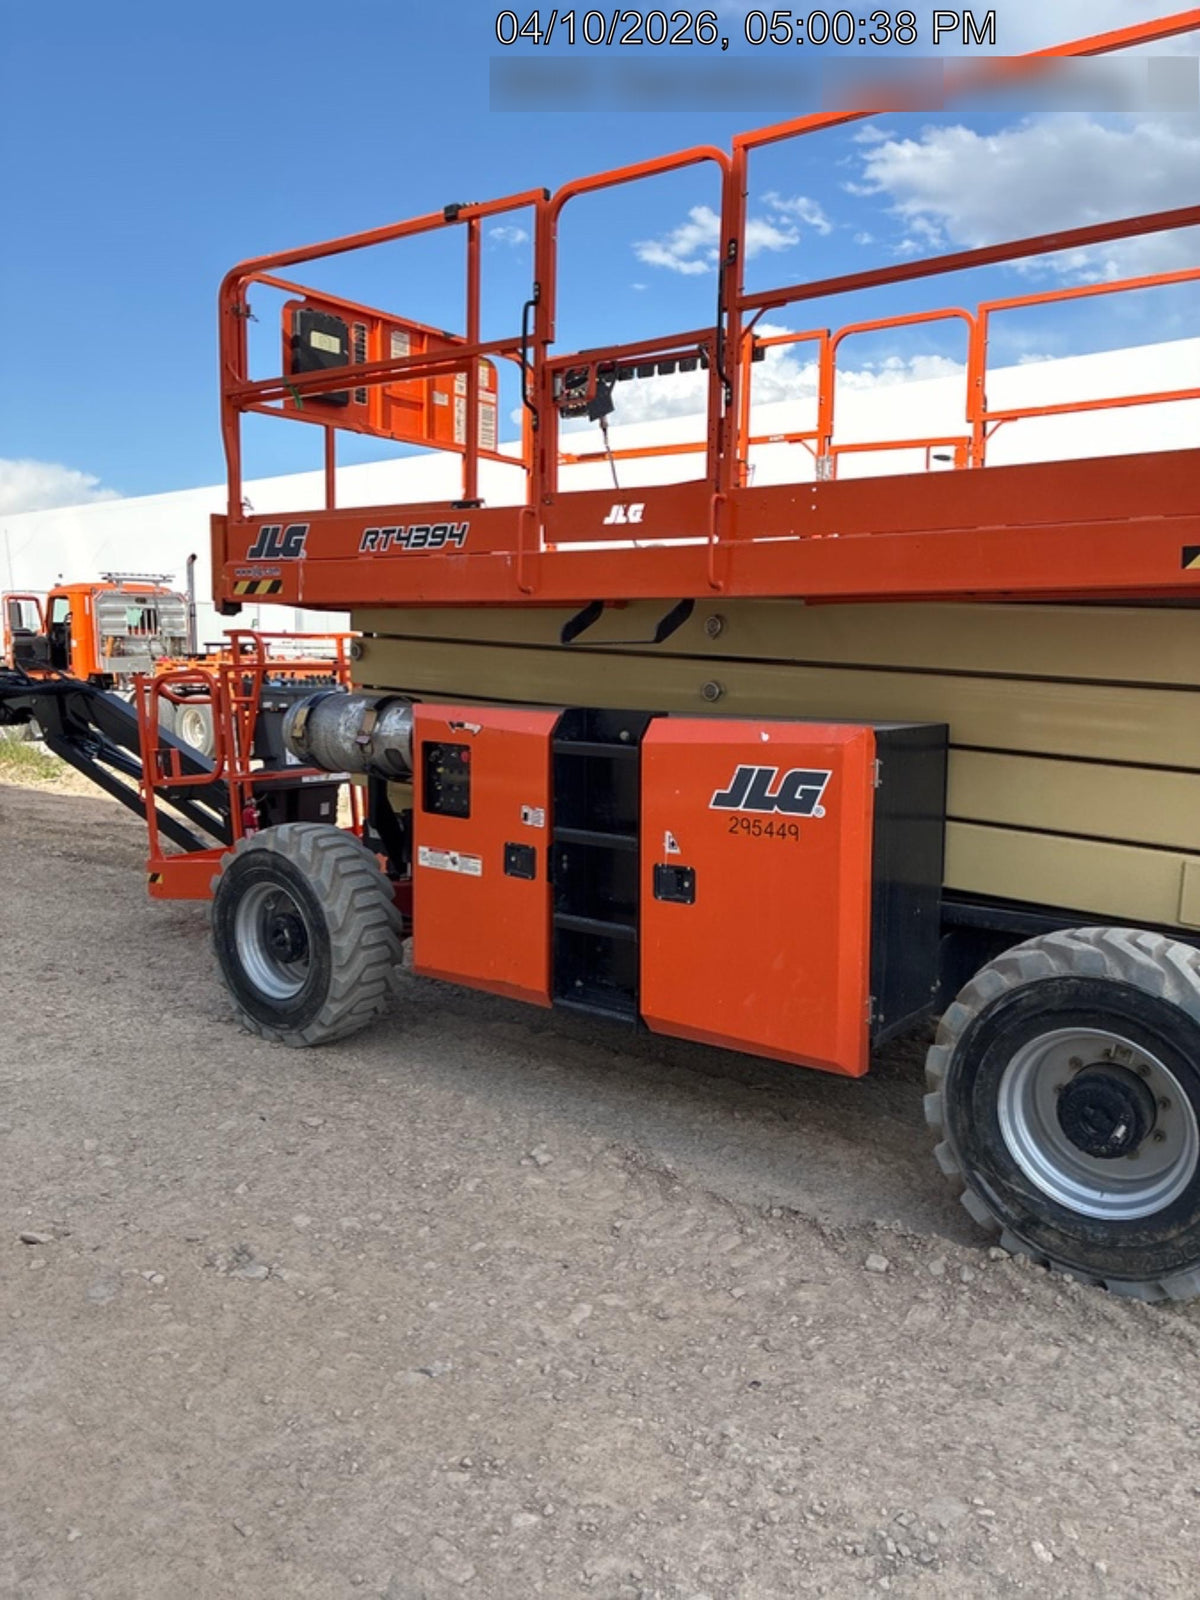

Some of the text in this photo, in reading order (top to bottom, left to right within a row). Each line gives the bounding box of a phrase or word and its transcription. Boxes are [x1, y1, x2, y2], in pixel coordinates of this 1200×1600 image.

[602, 502, 645, 525] JLG
[246, 523, 310, 560] JLG
[358, 521, 470, 552] RT4394
[708, 764, 832, 817] JLG
[728, 815, 800, 841] 295449
